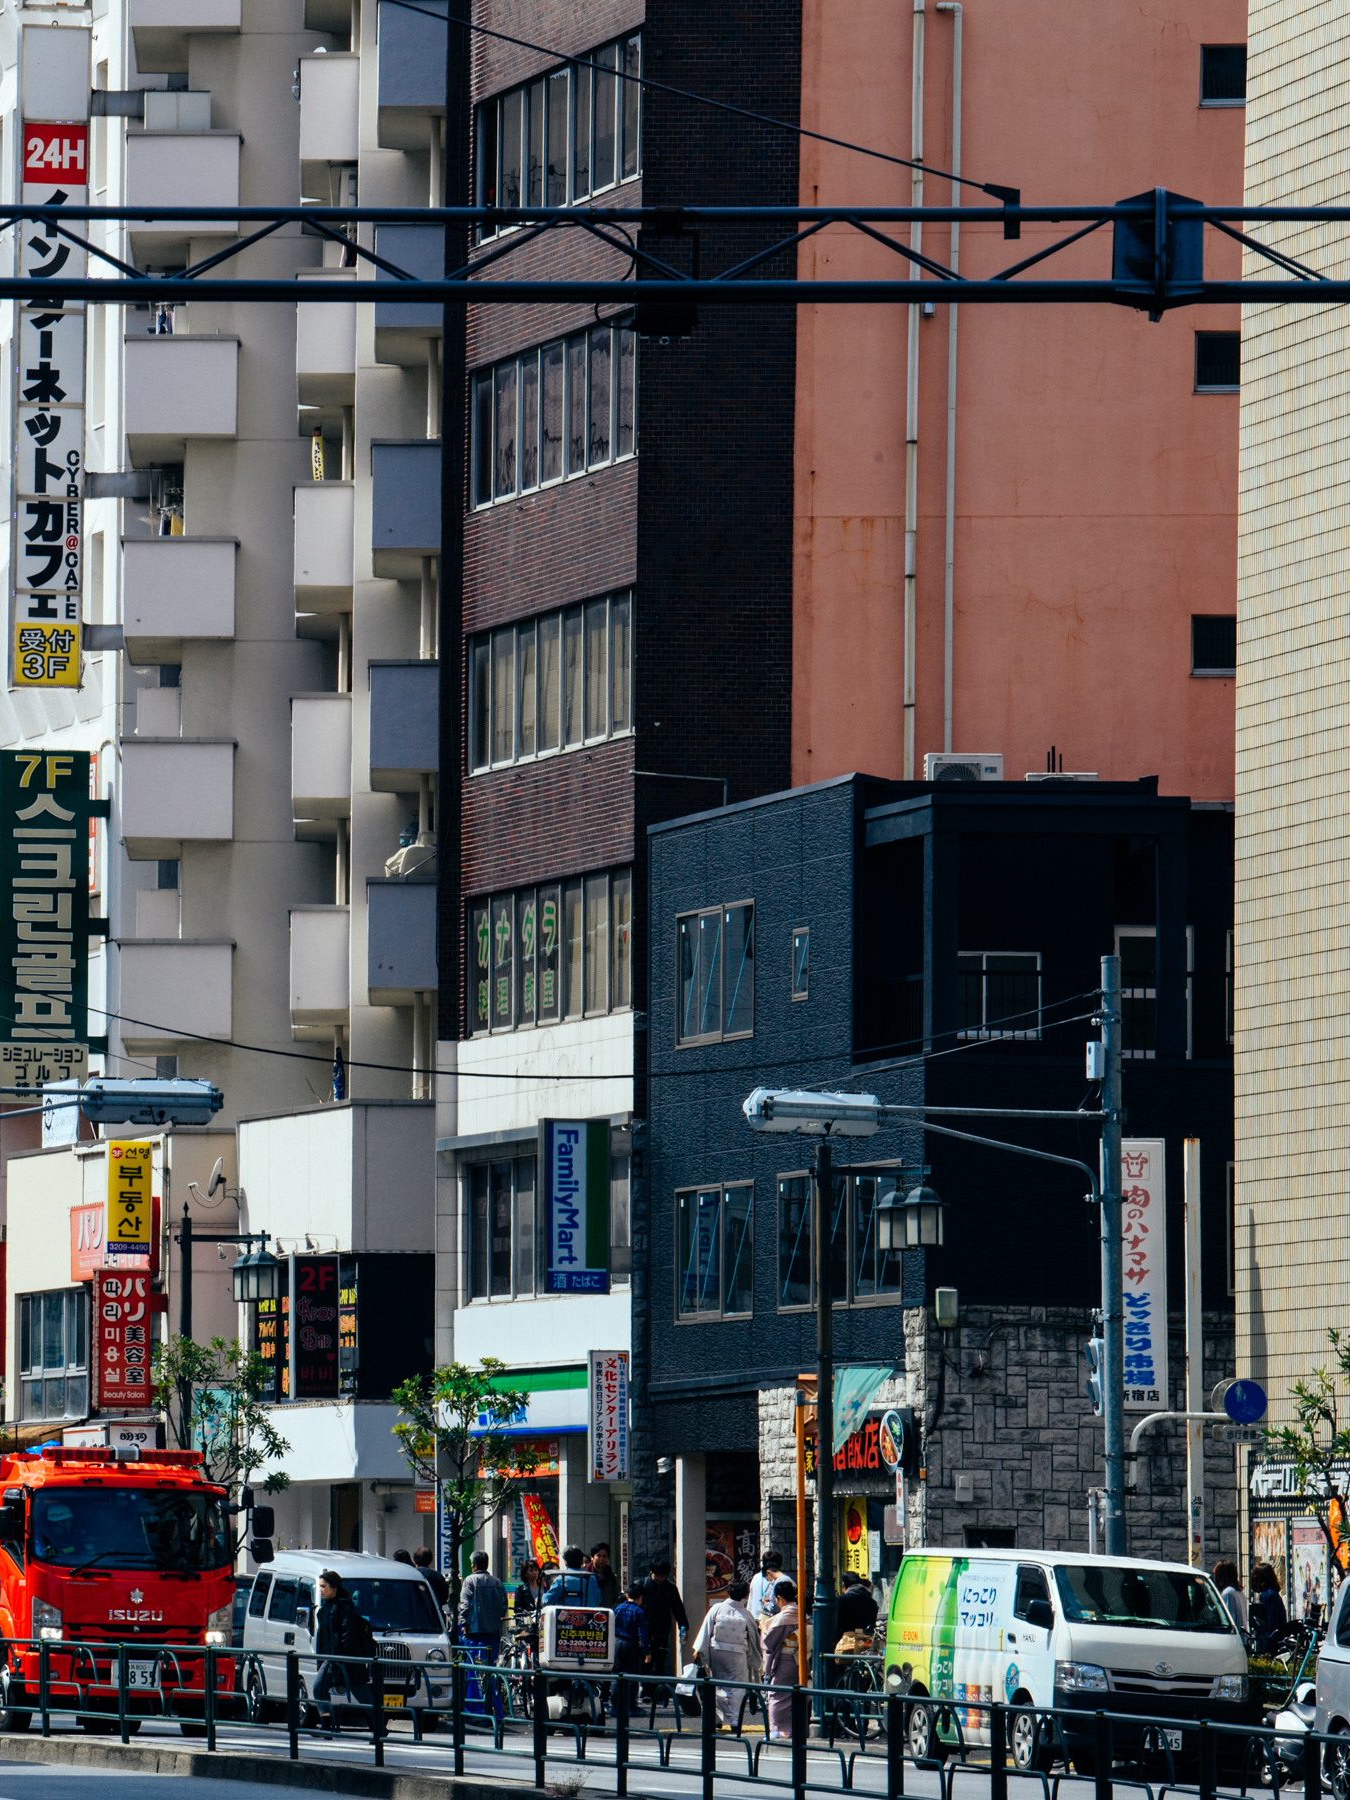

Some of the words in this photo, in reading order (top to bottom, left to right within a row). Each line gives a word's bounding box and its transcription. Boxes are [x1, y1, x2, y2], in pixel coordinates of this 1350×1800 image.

[26, 137, 85, 170] 24H
[65, 450, 80, 620] CYBER@CAFE
[19, 628, 75, 653] 受付
[22, 655, 70, 681] 3F
[14, 755, 74, 788] 7F
[11, 794, 77, 1040] 스크린골프
[2, 1046, 84, 1063] シミュレーション
[15, 1063, 70, 1081] ゴルフ
[111, 1149, 123, 1157] 3F
[125, 1148, 150, 1160] 선영
[117, 1165, 144, 1239] 부동산
[554, 1129, 580, 1265] FamilyMart
[78, 1209, 103, 1252] パリ
[1122, 1185, 1151, 1287] 肉のハナマサ
[109, 1243, 149, 1252] 3209-4490
[299, 1265, 335, 1291] 2F
[553, 1272, 568, 1289] 酒
[572, 1274, 600, 1288] たばこ
[103, 1278, 123, 1383] 파리미용실
[122, 1277, 146, 1385] パリ美容室
[1122, 1292, 1156, 1387] どっきり市場
[103, 1391, 126, 1399] Beauty
[127, 1390, 146, 1399] Salon
[604, 1358, 618, 1474] 文化センターアリラン
[617, 1472, 627, 1480] 8F
[962, 1586, 998, 1605] にっこり
[108, 1609, 164, 1622] ISUZU
[960, 1612, 994, 1628] マッコリ
[560, 1629, 604, 1641] 신주쿠반점
[903, 1631, 919, 1642] E-DON
[931, 1660, 953, 1676] にっこり
[931, 1678, 953, 1692] マッコリ
